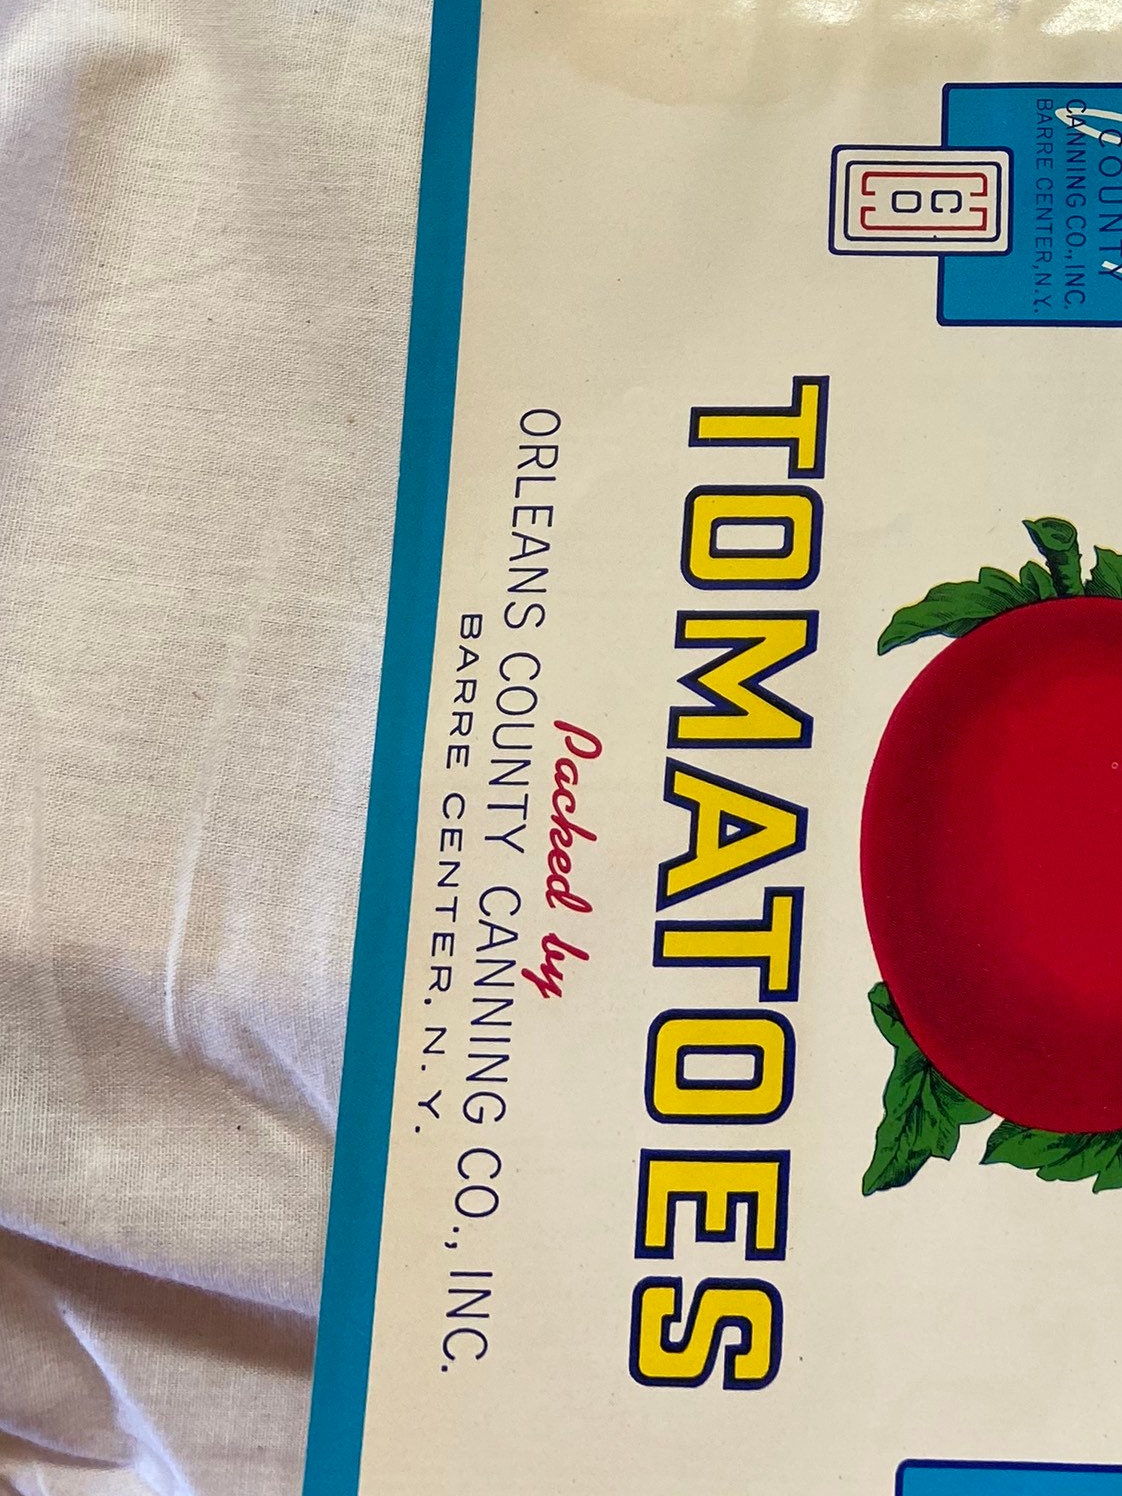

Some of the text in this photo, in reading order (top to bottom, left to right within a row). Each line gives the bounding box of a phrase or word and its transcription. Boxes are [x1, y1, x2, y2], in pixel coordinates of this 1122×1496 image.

[1035, 97, 1055, 169] BARRE
[1065, 97, 1087, 208] CANNING
[445, 613, 483, 770] BARRE
[440, 408, 562, 1373] ORLEANS COUNTY CANNING CO., INC.
[521, 719, 603, 1000] Packed by
[628, 375, 830, 1391] TOMATOES
